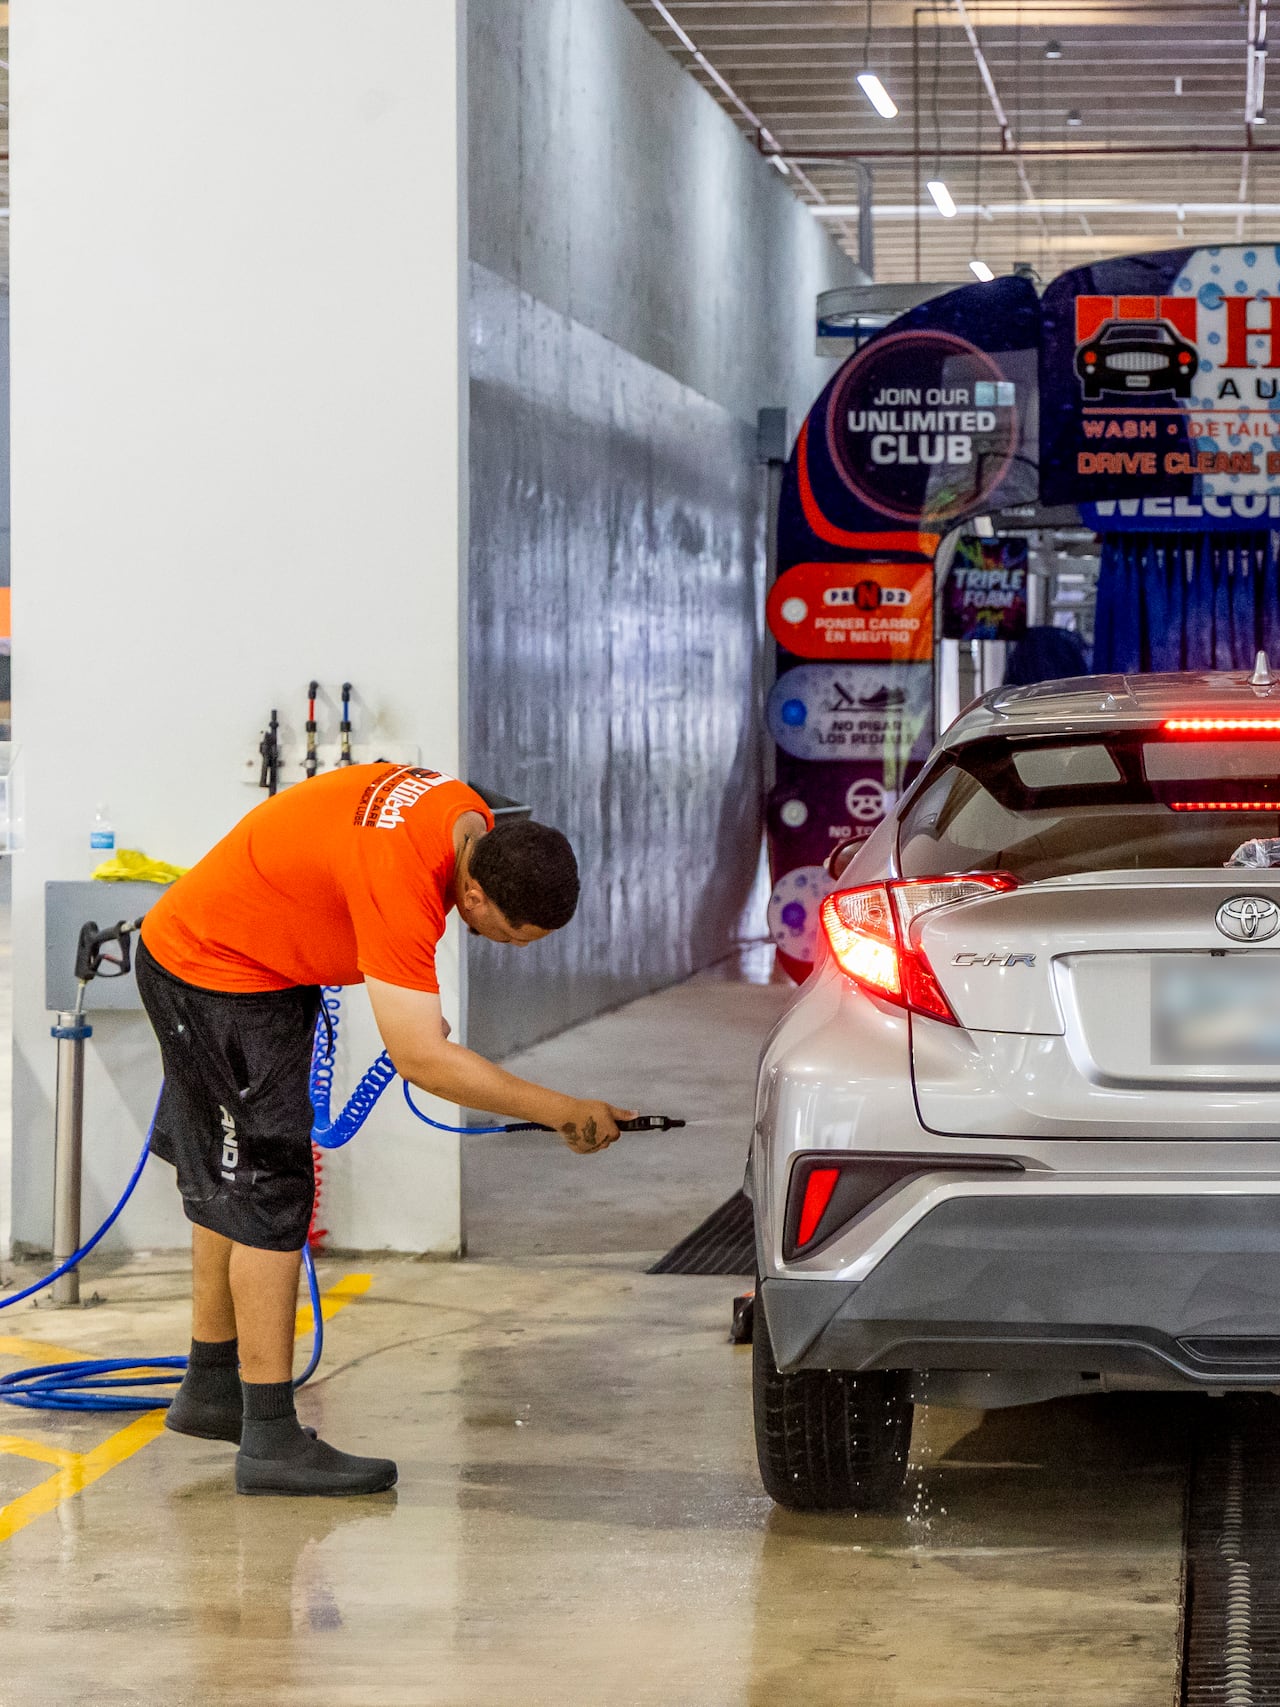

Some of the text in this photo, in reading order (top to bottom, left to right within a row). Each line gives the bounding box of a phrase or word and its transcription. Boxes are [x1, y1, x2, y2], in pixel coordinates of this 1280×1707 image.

[874, 388, 970, 406] JOIN OUR
[848, 411, 996, 432] UNLIMITED
[1082, 420, 1157, 438] WASH
[871, 434, 972, 465] CLUB
[1077, 452, 1157, 475] DRIVE
[954, 569, 1025, 589] TRIPLE
[963, 590, 1015, 608] FOAM
[815, 617, 920, 631] PONER CARRO
[825, 630, 910, 643] EN NEUTRO
[832, 721, 854, 732] NO
[819, 733, 847, 744] LOS
[828, 825, 852, 838] NO
[950, 952, 1037, 968] C-HR
[219, 1105, 239, 1181] AND1
